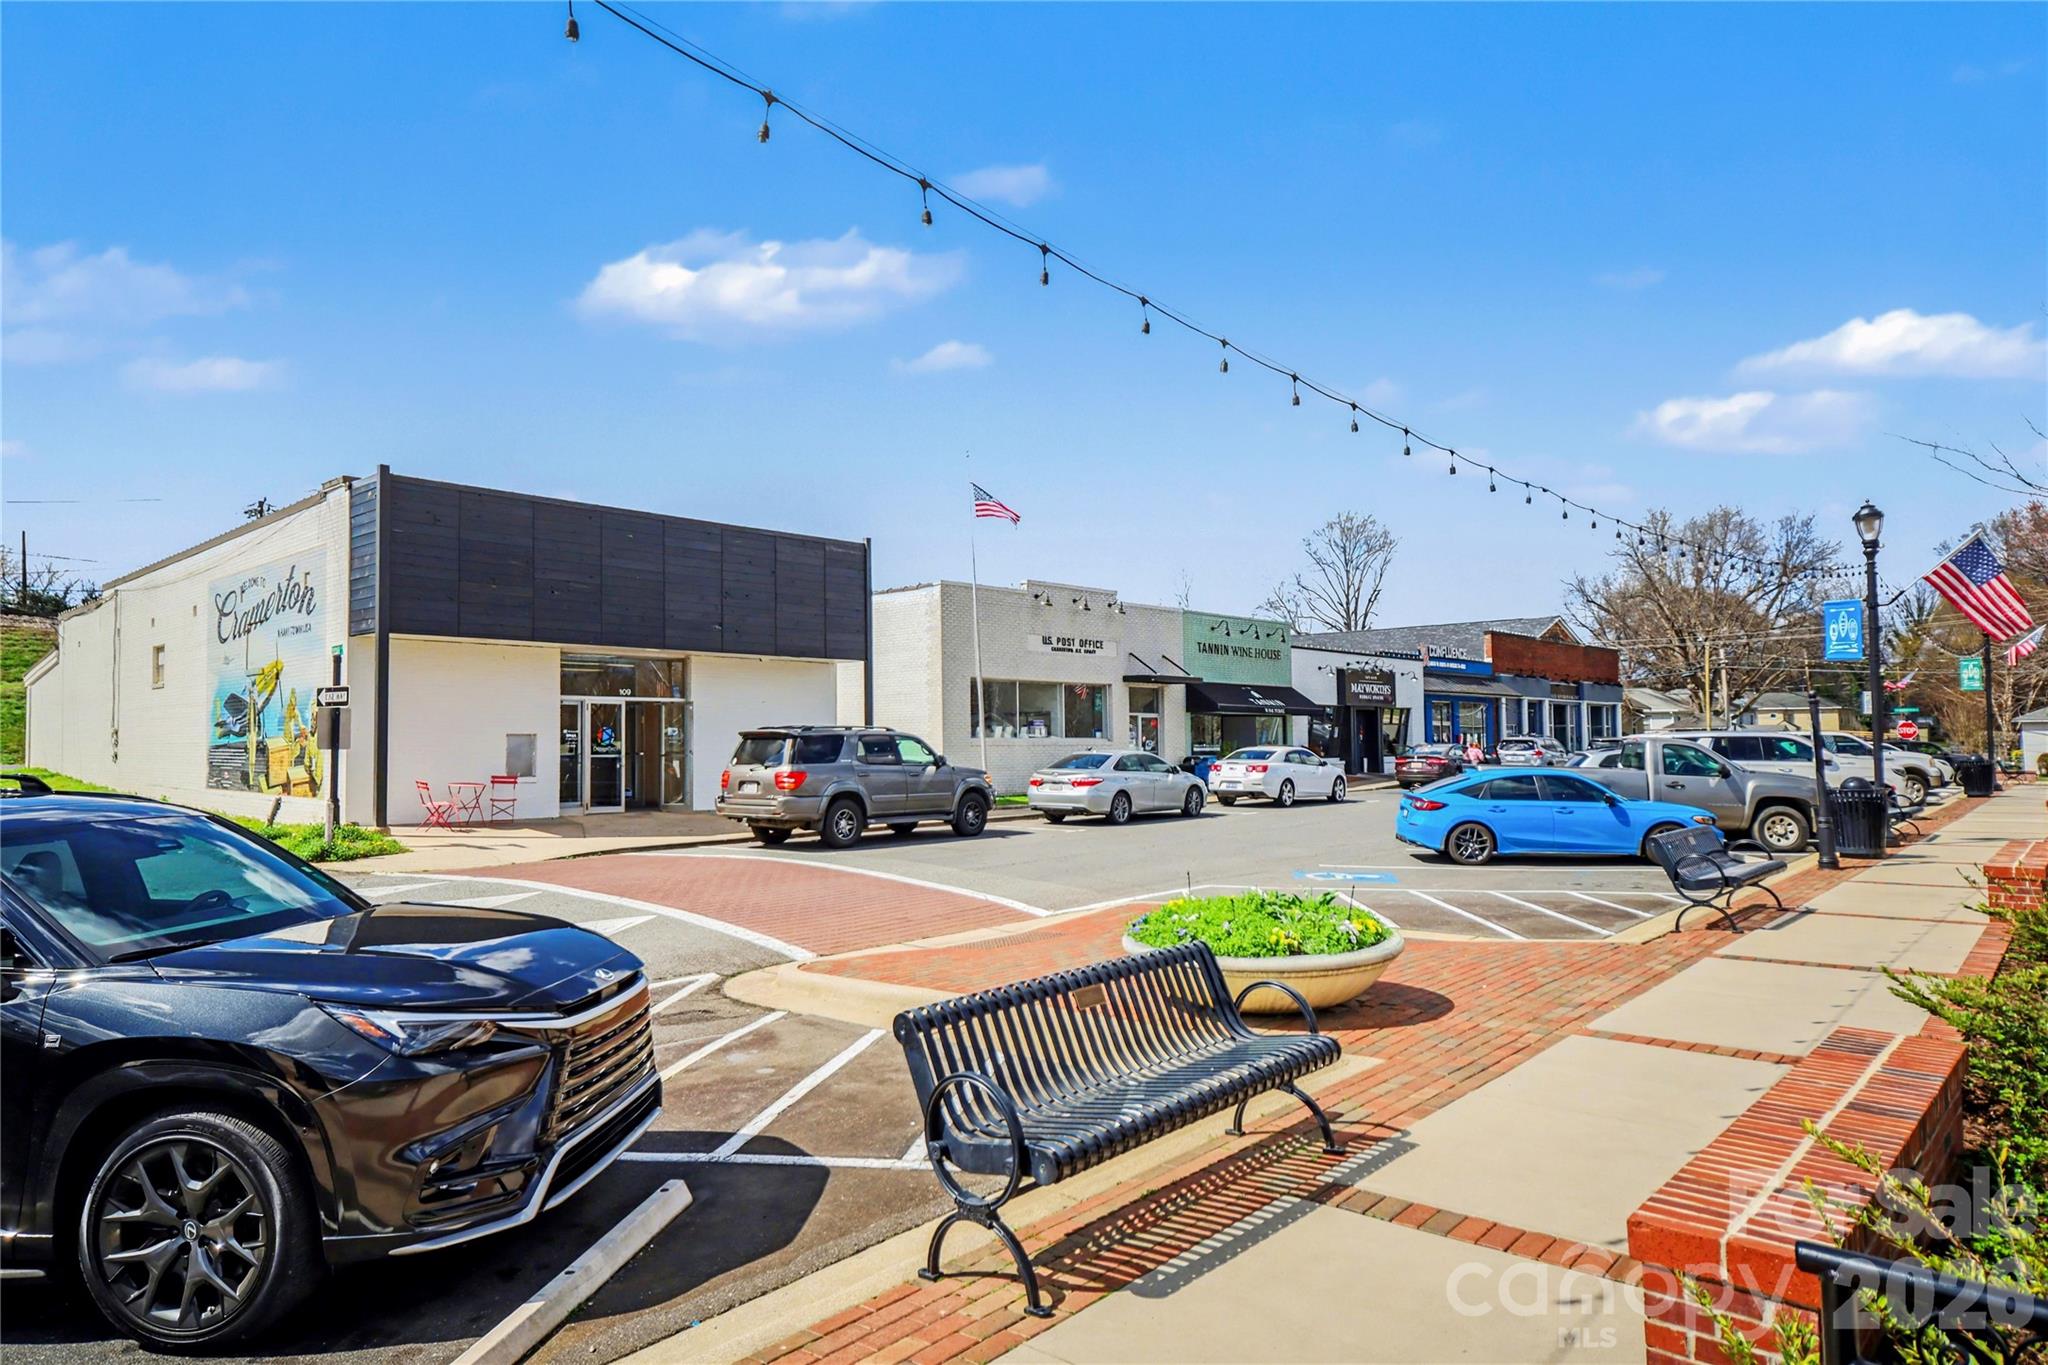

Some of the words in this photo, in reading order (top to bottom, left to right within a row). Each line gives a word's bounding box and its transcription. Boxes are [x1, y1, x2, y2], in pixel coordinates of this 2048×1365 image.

[215, 564, 317, 645] Cramerton
[1056, 636, 1076, 647] POST
[1079, 639, 1104, 650] OFFICE
[1197, 641, 1229, 656] TANNIN
[1231, 645, 1253, 658] WINE
[1254, 647, 1281, 660] HOUSE
[1429, 644, 1468, 660] CONFLUENCE
[619, 688, 632, 696] 109
